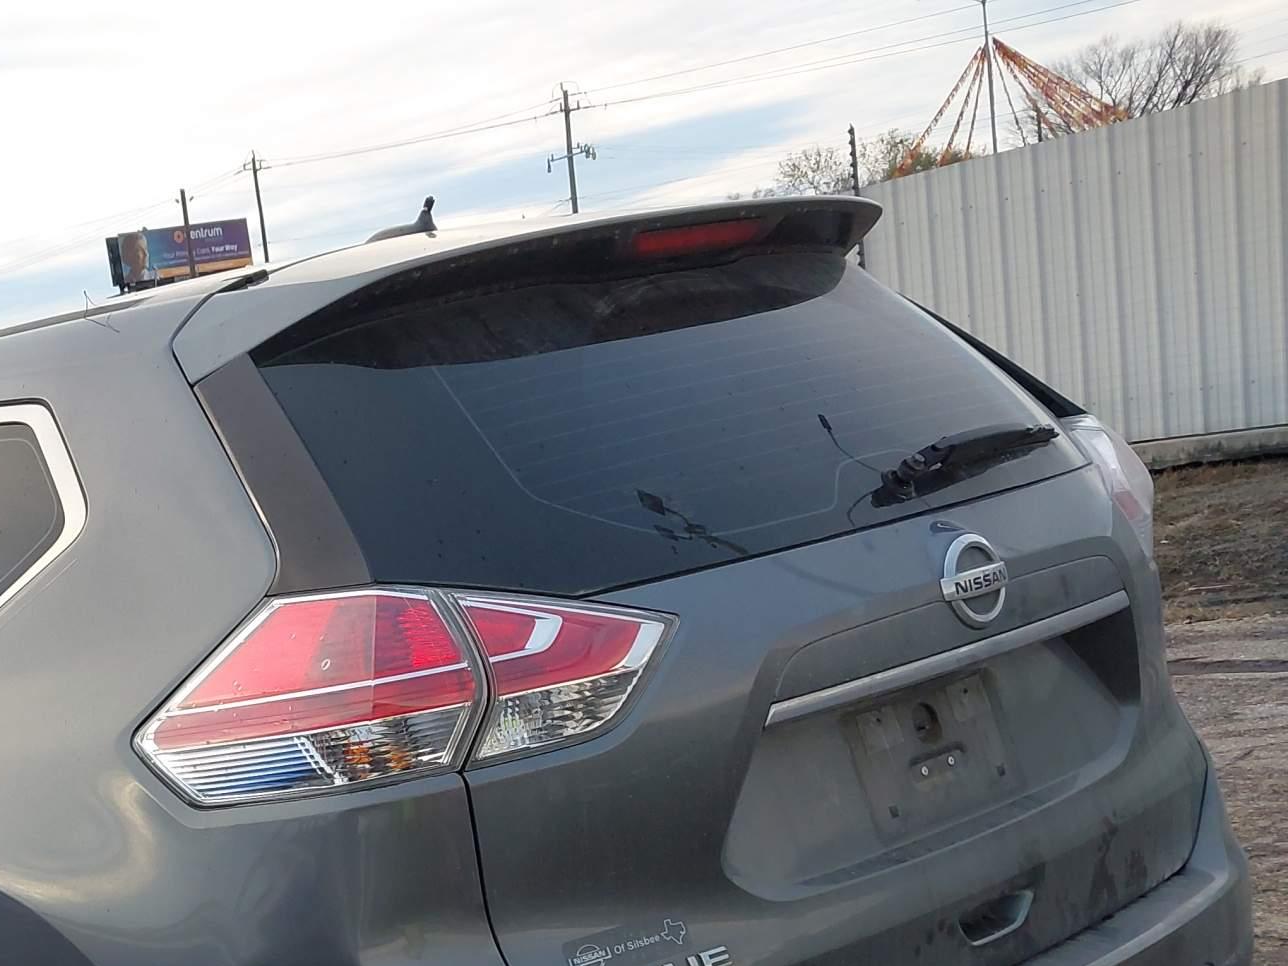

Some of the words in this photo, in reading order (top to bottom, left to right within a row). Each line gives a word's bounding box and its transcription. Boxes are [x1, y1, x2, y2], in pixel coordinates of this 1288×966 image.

[954, 568, 1007, 595] NISSAN
[573, 949, 607, 965] NISSAN
[627, 934, 661, 951] Silsbee
